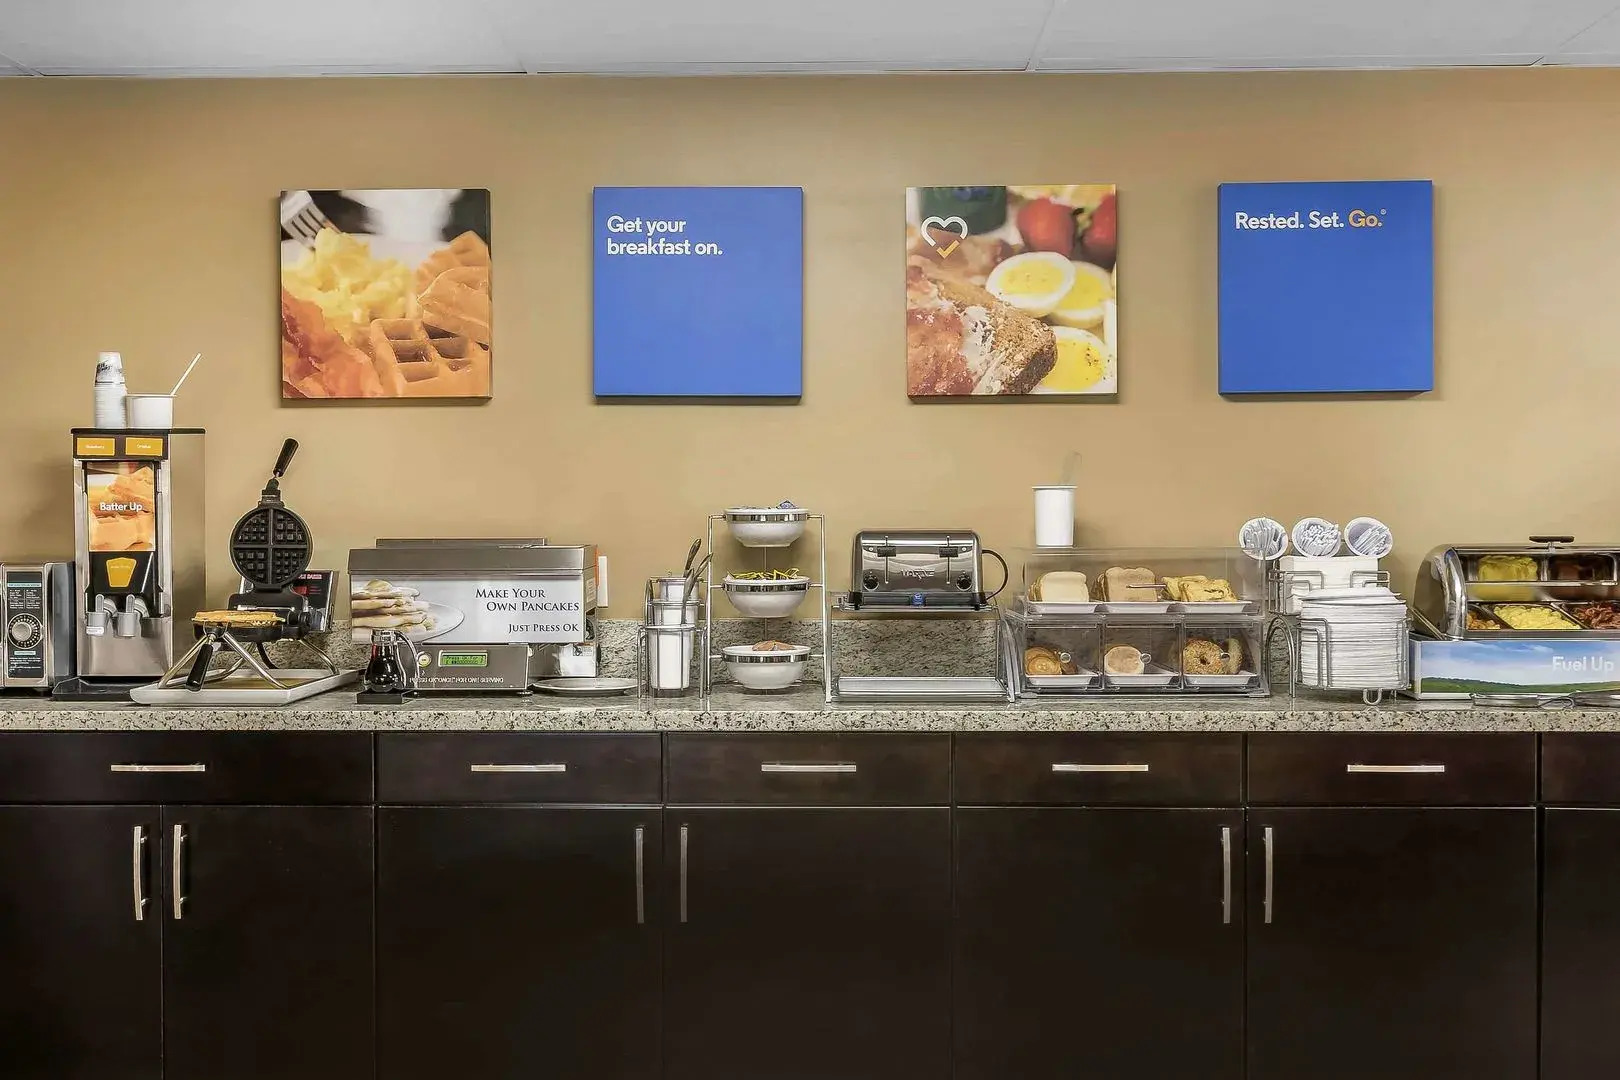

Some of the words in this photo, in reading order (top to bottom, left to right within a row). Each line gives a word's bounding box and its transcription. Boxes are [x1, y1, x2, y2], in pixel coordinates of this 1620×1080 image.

[607, 215, 642, 233] Get
[646, 219, 686, 236] your
[1236, 212, 1304, 230] Rested.
[1309, 211, 1344, 228] Set.
[607, 238, 691, 255] breakfast
[695, 241, 723, 255] on.
[100, 502, 128, 511] Batter
[130, 502, 143, 512] Up
[476, 589, 509, 598] MAKE
[512, 589, 546, 598] YOUR
[486, 602, 517, 611] OWN
[521, 602, 580, 611] PANCAKES
[508, 624, 530, 634] JUST
[533, 624, 560, 632] PRESS
[563, 624, 579, 632] OK
[1552, 656, 1587, 672] Fuel
[1591, 656, 1615, 677] Up
